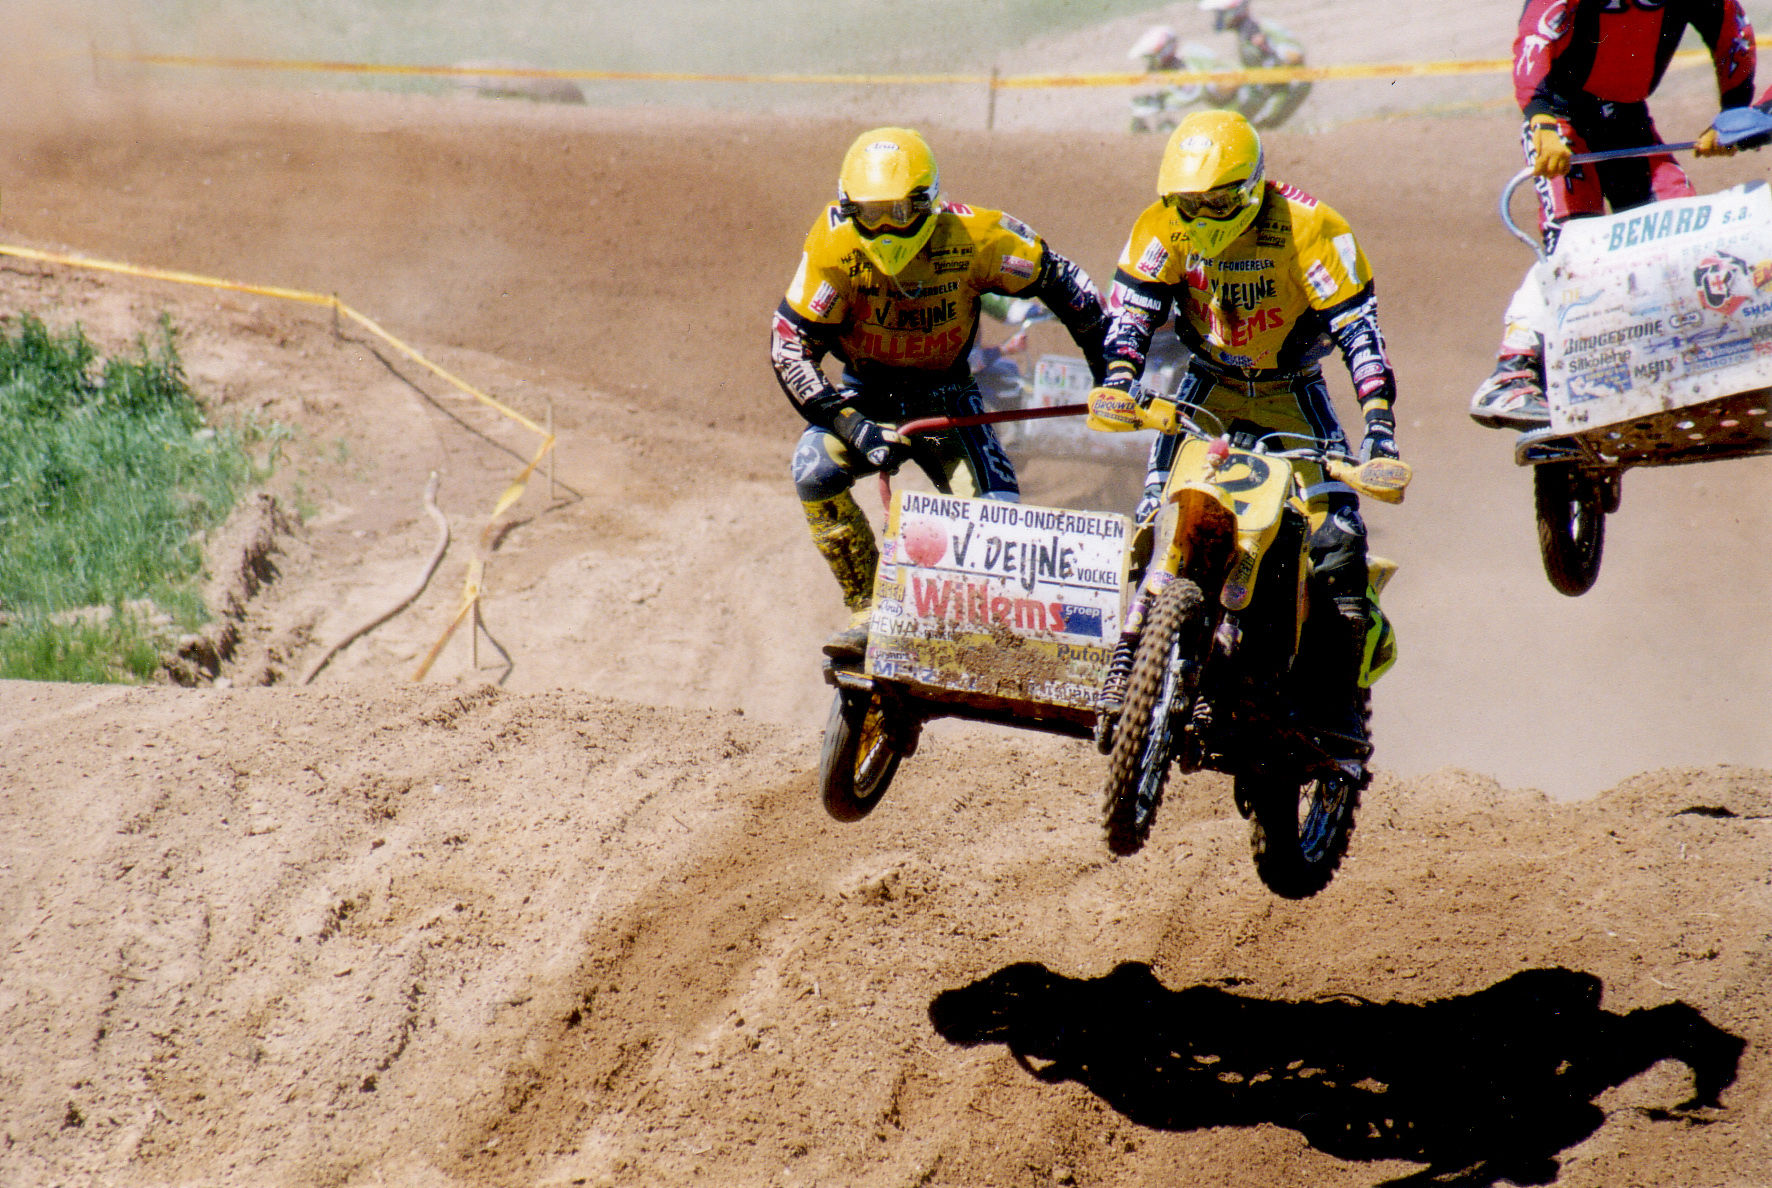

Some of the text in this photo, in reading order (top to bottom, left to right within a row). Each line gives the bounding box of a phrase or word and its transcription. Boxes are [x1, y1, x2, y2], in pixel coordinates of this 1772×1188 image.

[1608, 205, 1712, 251] BENARD
[902, 494, 1124, 538] JAPANSE AUTO-ONDERDELEN
[953, 521, 976, 568] V.
[911, 576, 1066, 633] Willems
[1057, 643, 1114, 665] Putoli
